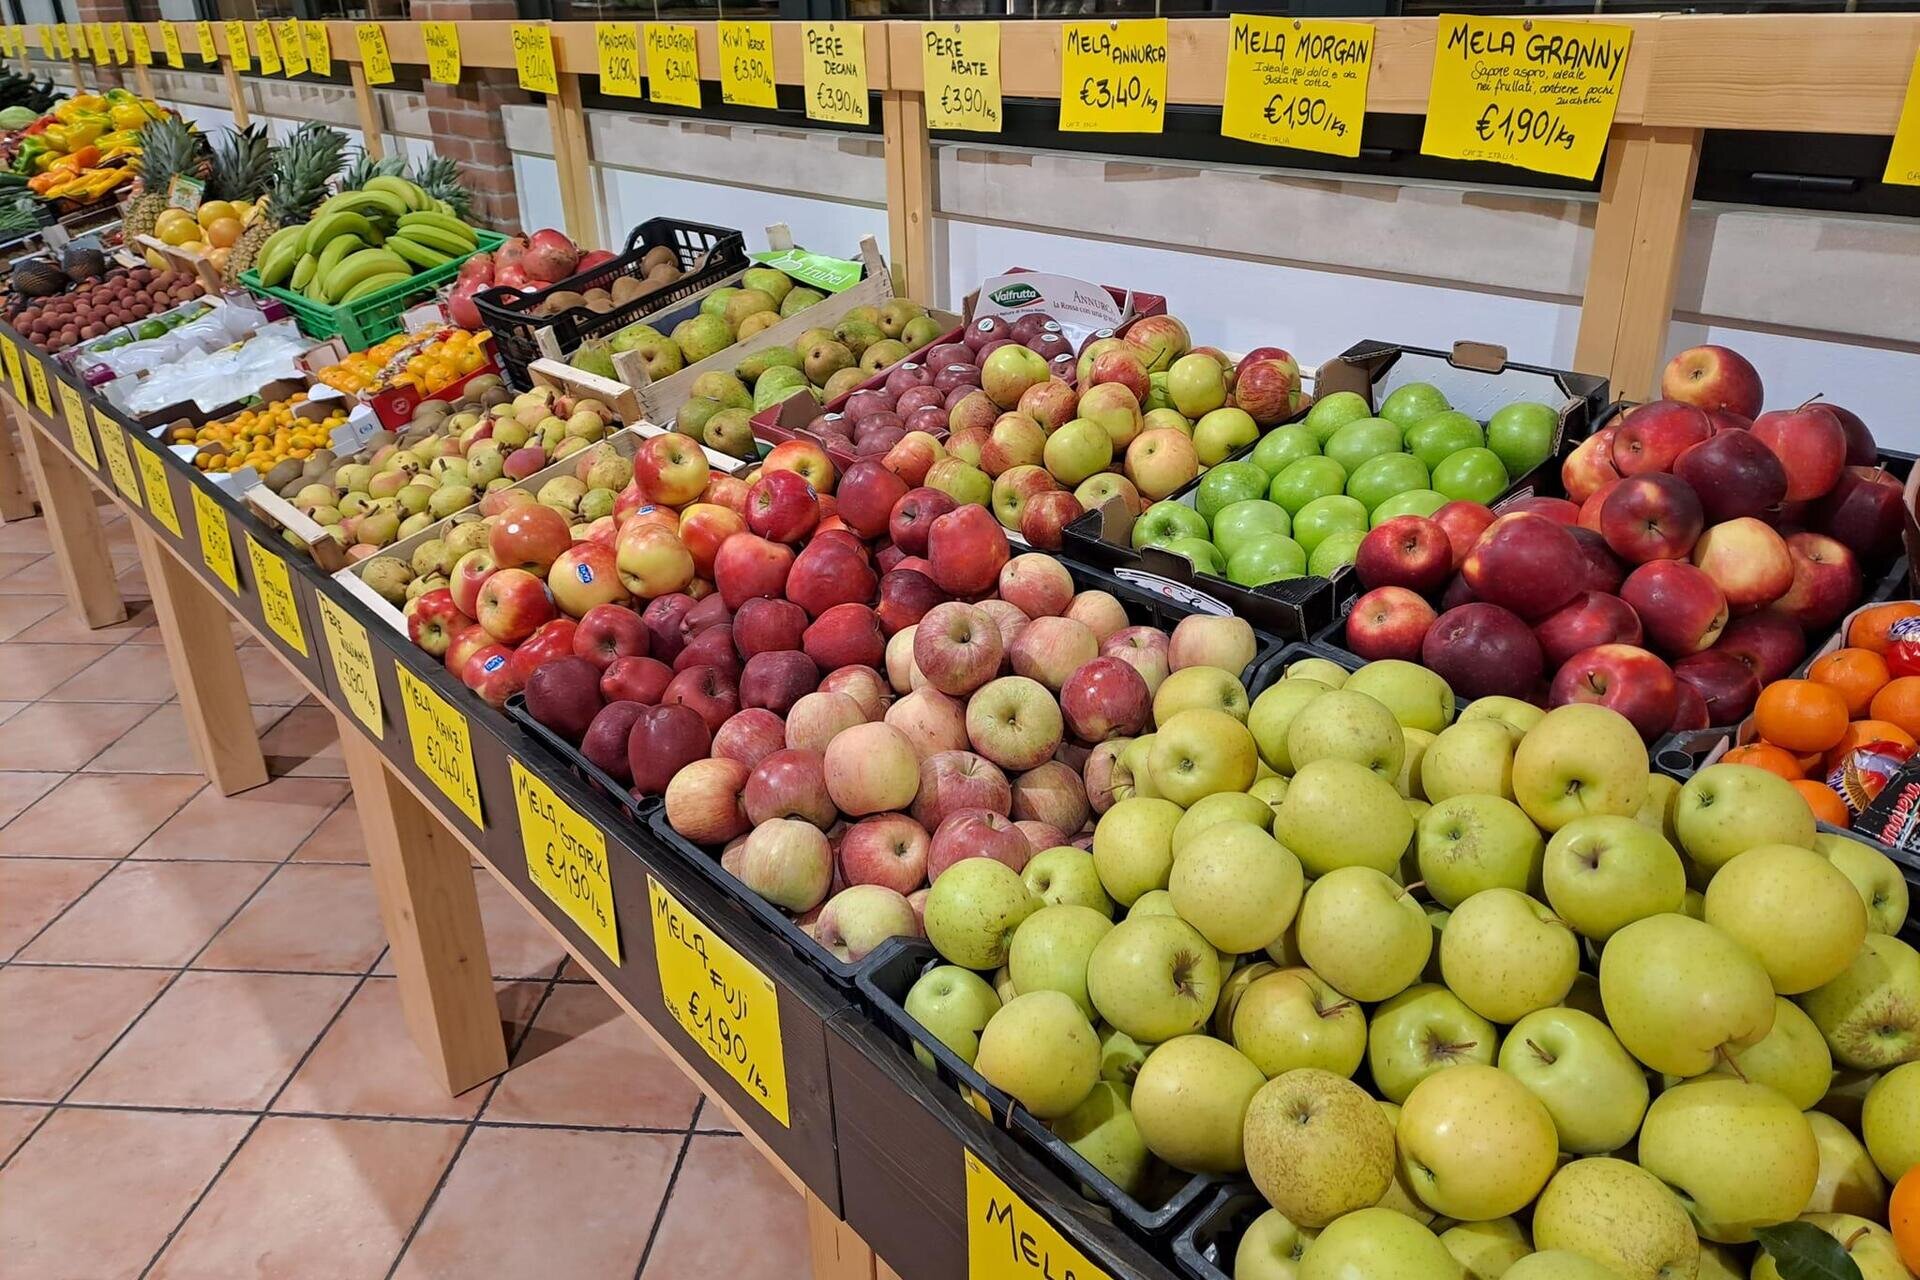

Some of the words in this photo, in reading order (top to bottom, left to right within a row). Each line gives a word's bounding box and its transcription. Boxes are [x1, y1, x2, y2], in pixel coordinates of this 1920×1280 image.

[807, 29, 844, 58] PERE
[926, 31, 963, 58] PERE
[1068, 28, 1110, 57] MELA
[1112, 44, 1166, 64] ANNURCA
[1235, 23, 1285, 61] MELA
[1295, 32, 1369, 65] MORGAN
[1448, 22, 1515, 61] MELA
[1526, 34, 1624, 81] GRANNY
[824, 60, 858, 77] DECANA
[951, 60, 989, 76] ABATE
[1253, 62, 1289, 74] Ideale
[1264, 74, 1298, 86] gustare
[1304, 78, 1332, 88] cotta
[1471, 60, 1510, 81] Sapore
[1553, 67, 1586, 80] ideale
[817, 82, 863, 118] €3,90/kg
[1080, 76, 1158, 113] €3,40/kg
[1476, 79, 1491, 91] nei
[1539, 81, 1579, 94] contiene
[1476, 103, 1575, 150] €1,90/kg
[994, 289, 1036, 302] Valfrutta
[405, 675, 435, 720] MELA
[520, 774, 557, 836] MELA
[560, 822, 606, 882] STARK
[546, 842, 608, 928] €1,90/kg
[657, 897, 709, 969] MELA
[986, 1197, 1076, 1280] MEL
